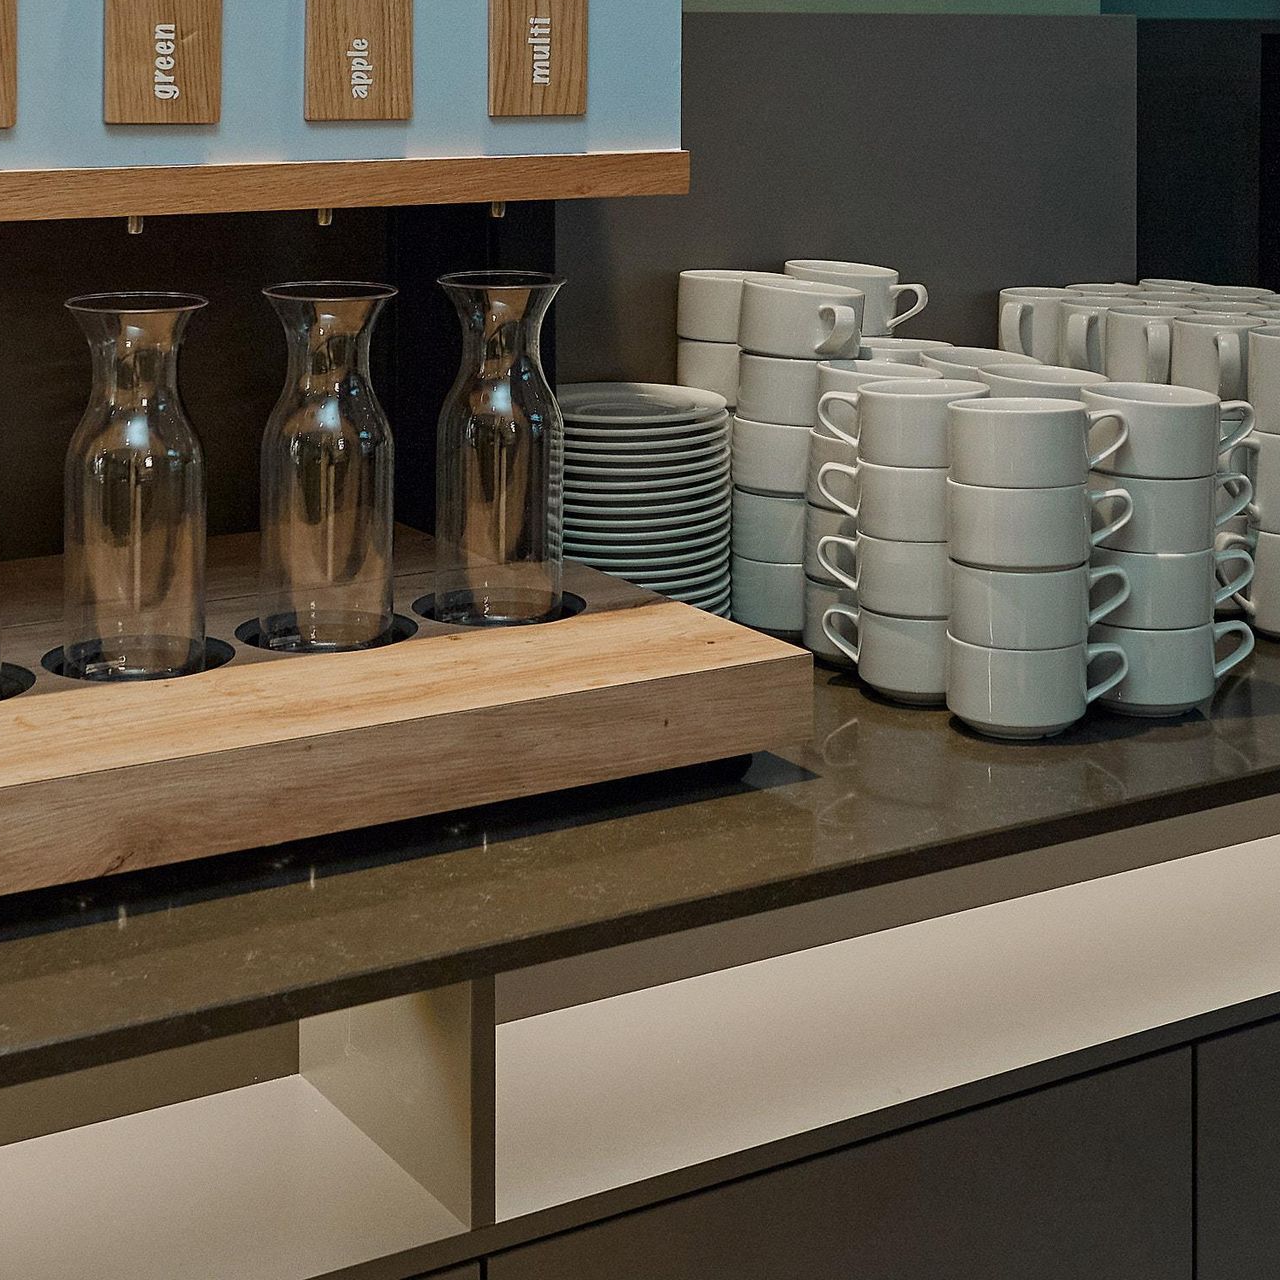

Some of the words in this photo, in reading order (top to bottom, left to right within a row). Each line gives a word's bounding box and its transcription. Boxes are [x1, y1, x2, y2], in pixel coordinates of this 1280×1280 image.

[154, 23, 180, 100] green
[346, 38, 373, 99] apple
[528, 17, 551, 86] multi
